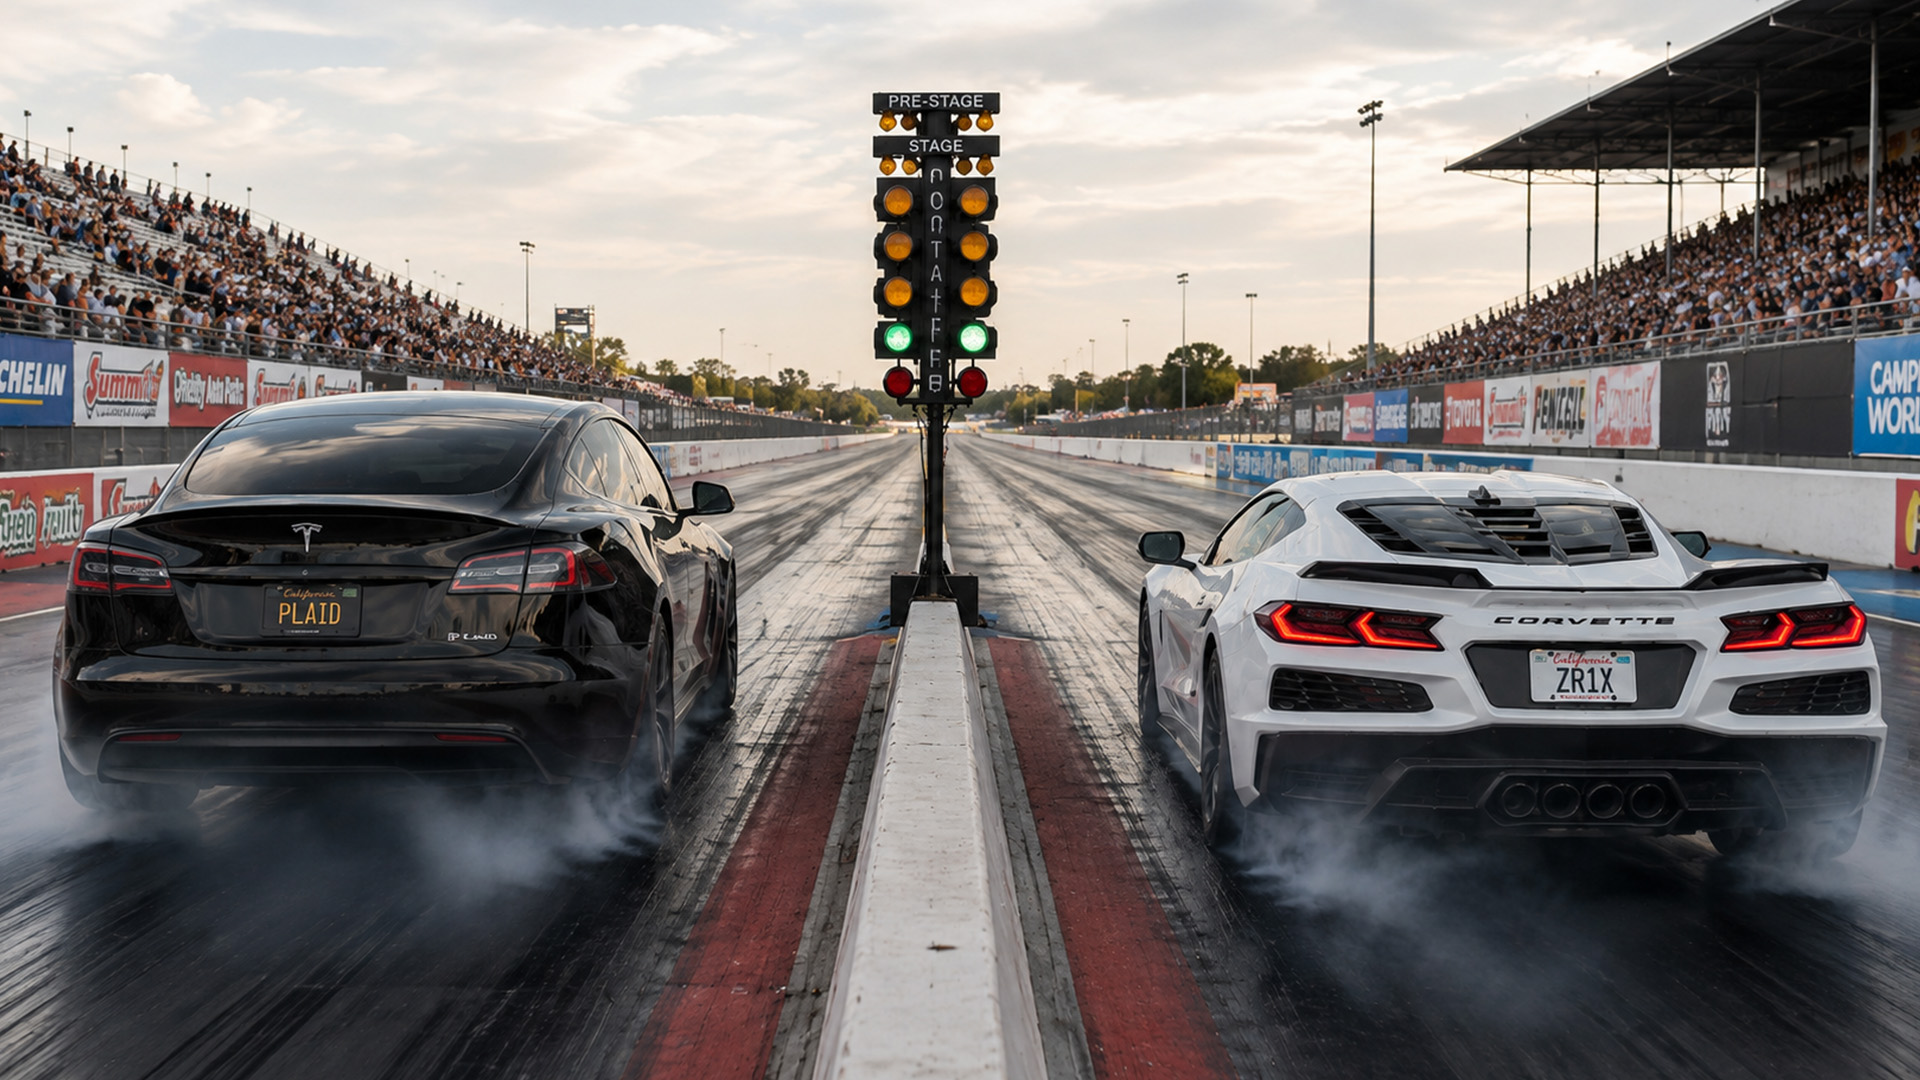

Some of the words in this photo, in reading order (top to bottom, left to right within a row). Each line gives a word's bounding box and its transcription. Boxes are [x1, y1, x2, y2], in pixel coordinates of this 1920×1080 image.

[889, 94, 984, 109] PRE-STAGE
[909, 139, 964, 152] STAGE
[1870, 360, 1920, 395] CAMP
[278, 602, 341, 625] PLAID
[1494, 617, 1675, 625] CORVETTE
[1556, 667, 1614, 693] ZR1X
